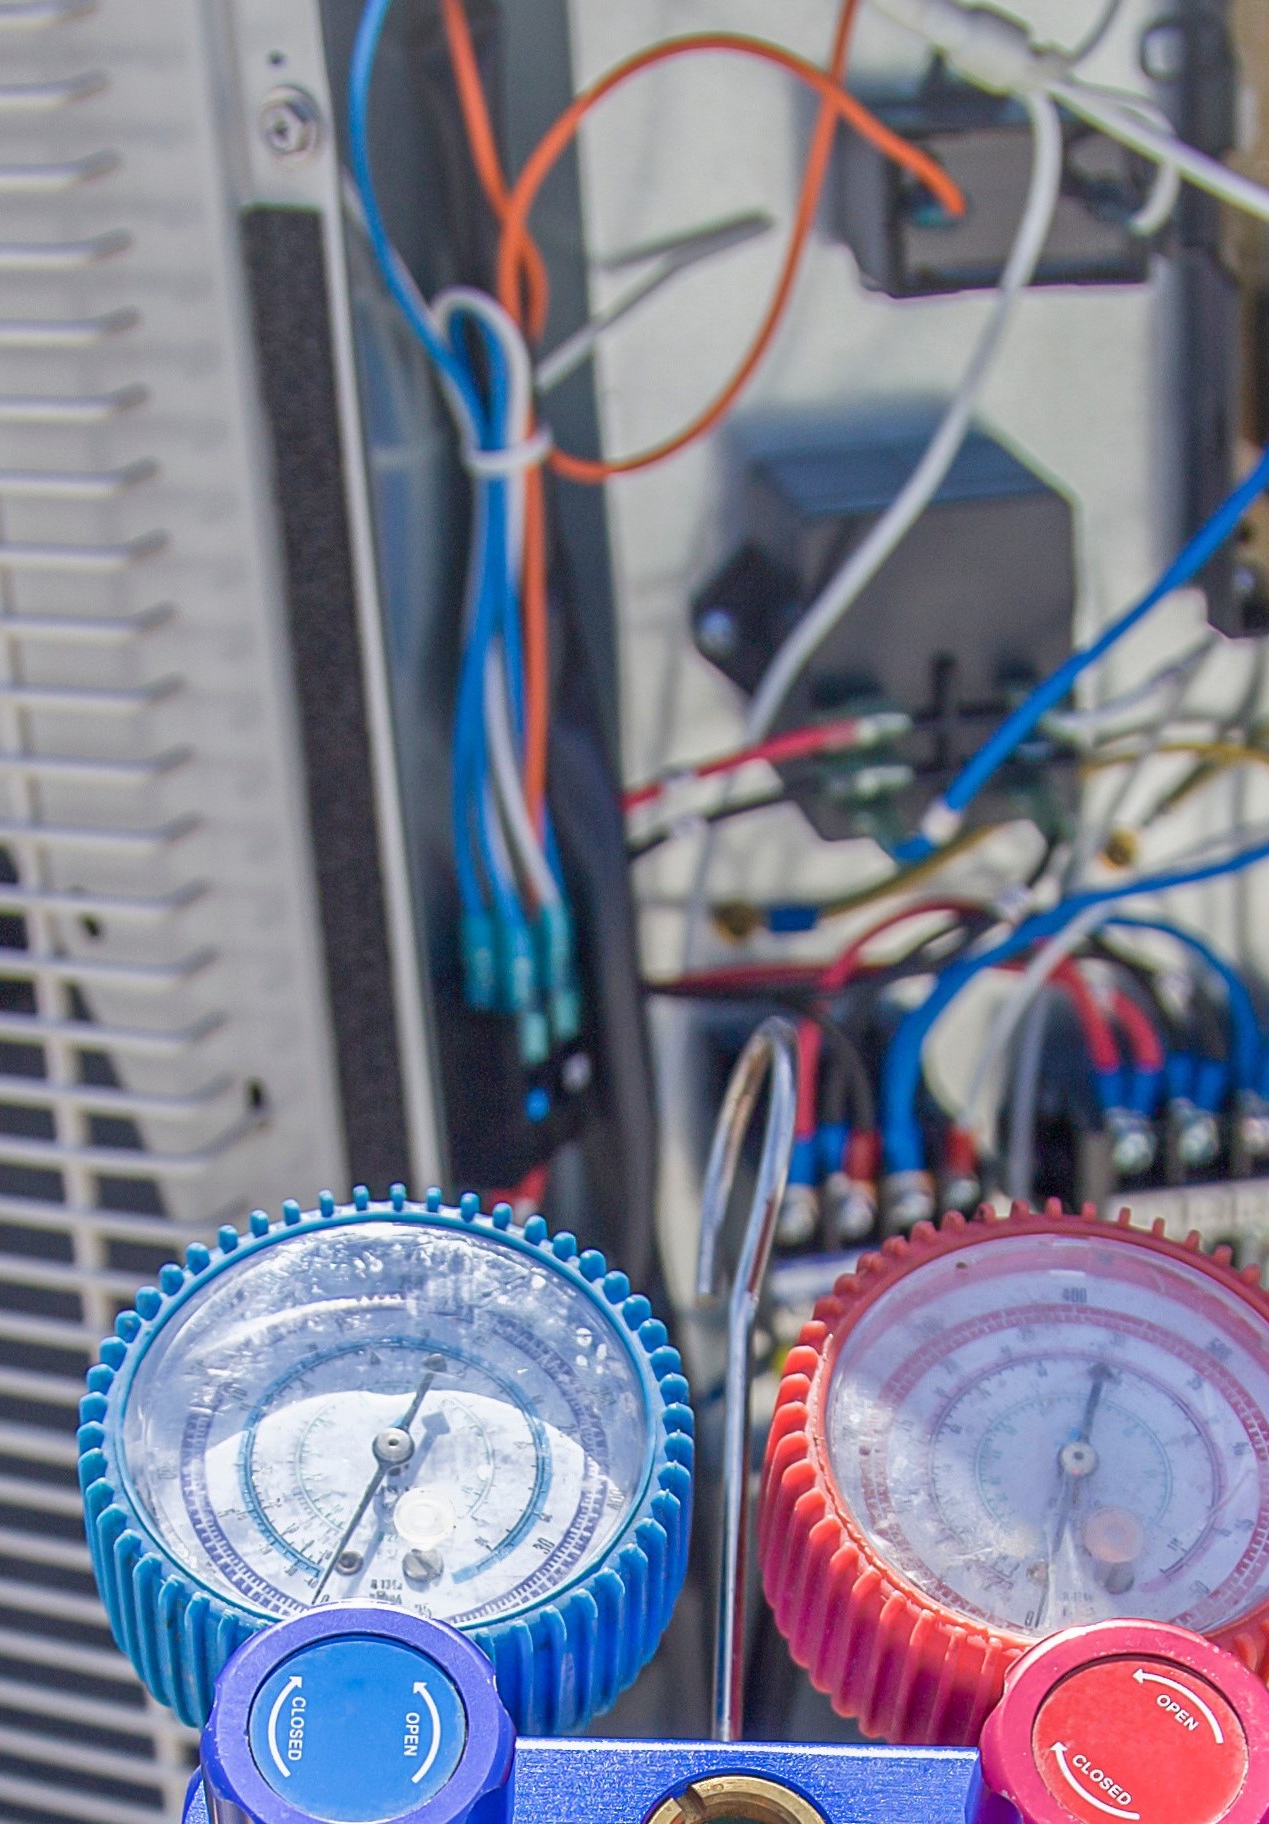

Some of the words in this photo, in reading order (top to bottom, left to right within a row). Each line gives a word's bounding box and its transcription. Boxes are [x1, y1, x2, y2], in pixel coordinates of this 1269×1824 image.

[288, 1696, 307, 1761] CLOSED
[403, 1712, 420, 1757] OPEN
[1156, 1694, 1199, 1731] OPEN
[1072, 1754, 1133, 1806] CLOSED
